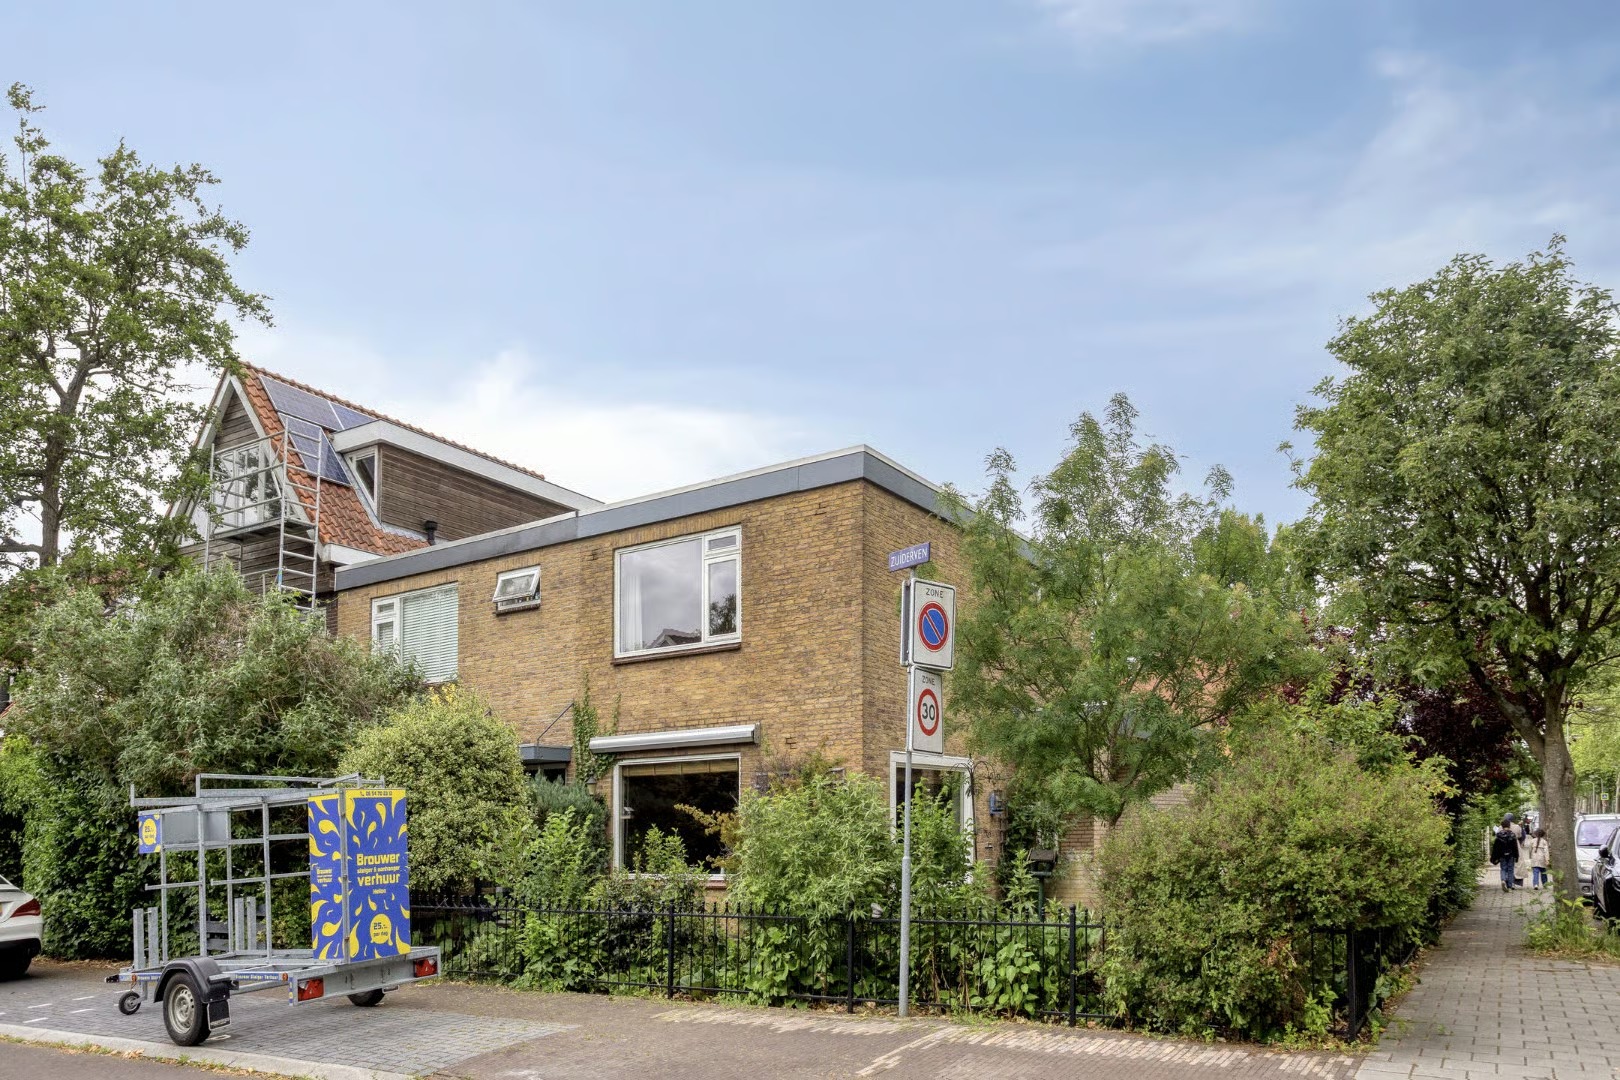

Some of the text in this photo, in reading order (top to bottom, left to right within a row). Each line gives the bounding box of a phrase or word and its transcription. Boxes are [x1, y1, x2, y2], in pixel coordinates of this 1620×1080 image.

[890, 547, 928, 567] ZUIDERVEN
[926, 588, 944, 598] ZONE
[922, 675, 935, 685] ZONE
[922, 703, 935, 720] 30
[356, 853, 401, 866] Brouwer
[357, 873, 401, 887] verhuur
